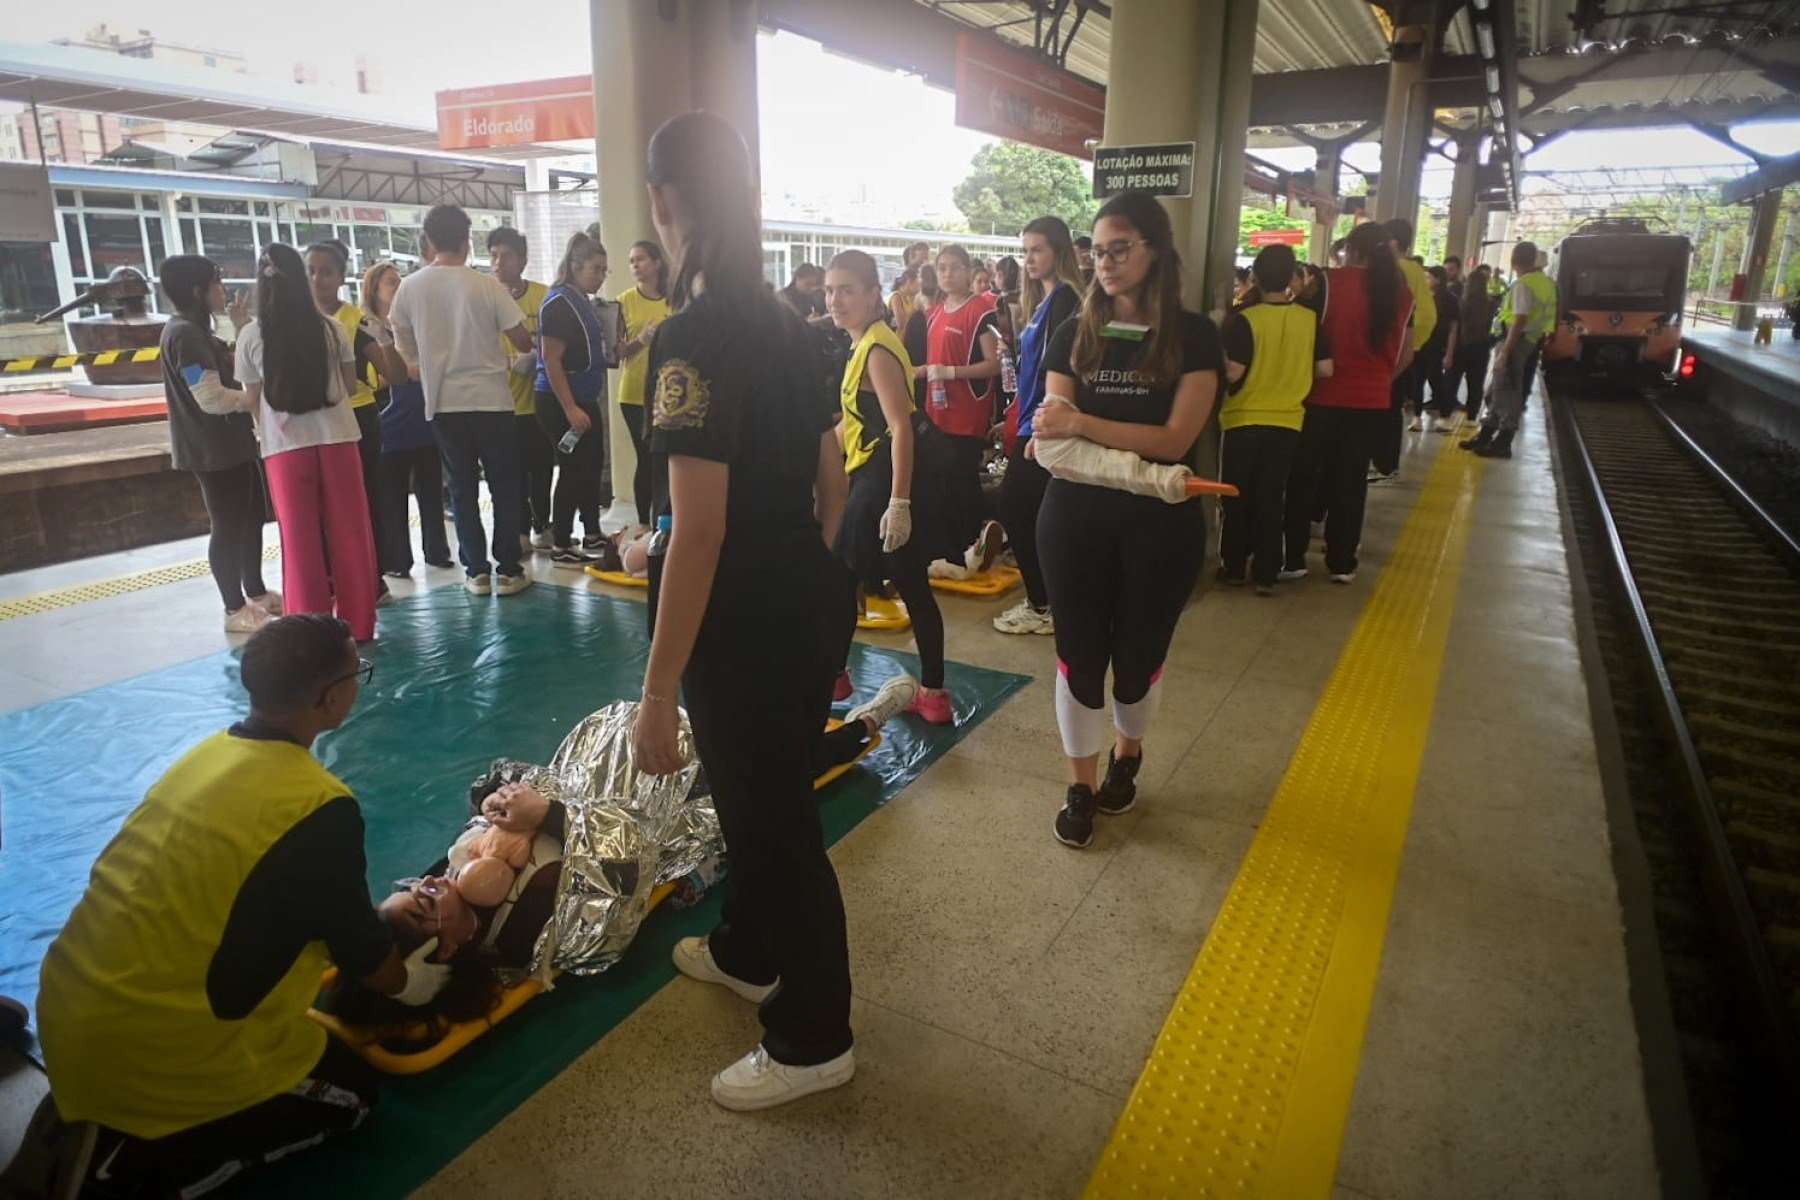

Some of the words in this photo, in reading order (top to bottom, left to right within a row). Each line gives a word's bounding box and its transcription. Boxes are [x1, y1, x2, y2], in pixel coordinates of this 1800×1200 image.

[463, 114, 536, 137] Eldorado
[1097, 154, 1143, 171] LOTAÇÃO
[1106, 175, 1125, 189] 300
[1127, 173, 1179, 189] PESSOAS
